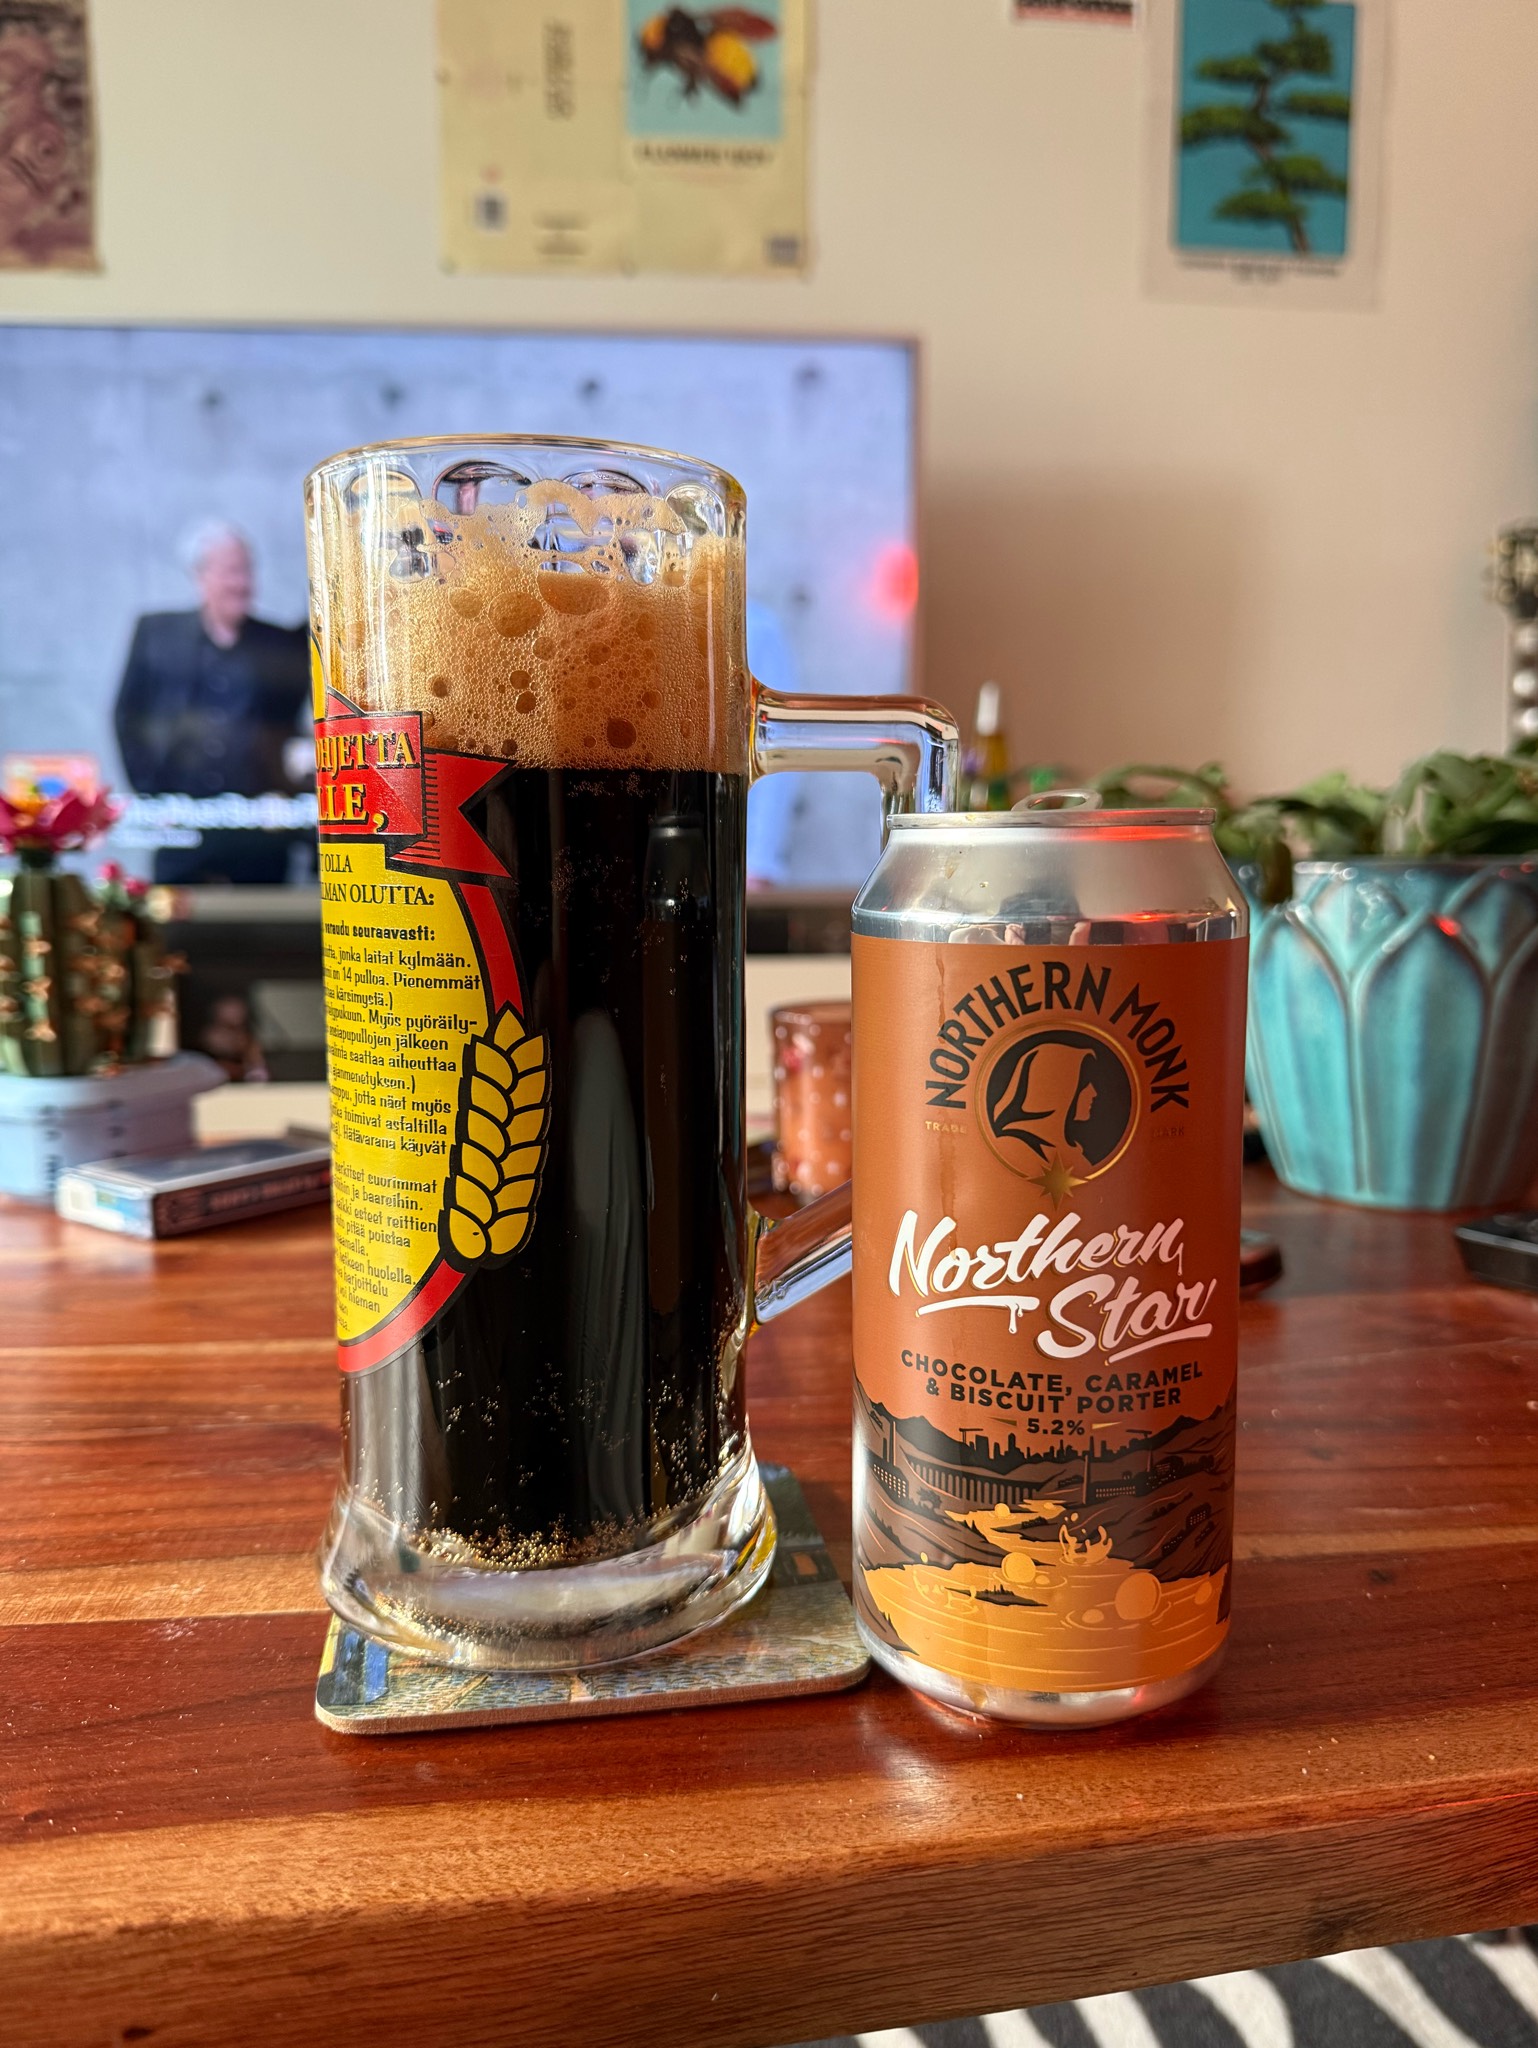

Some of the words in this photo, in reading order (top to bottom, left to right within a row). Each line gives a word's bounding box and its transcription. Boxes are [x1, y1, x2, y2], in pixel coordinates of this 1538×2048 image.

[324, 853, 352, 873] OLLA
[349, 885, 435, 906] OLUTTA:
[352, 924, 436, 942] seuraavasti:
[337, 947, 361, 965] jonka
[363, 948, 395, 965] laitat
[398, 950, 472, 970] kylmään.
[342, 967, 352, 982] 14
[354, 968, 390, 987] pulloa.
[393, 971, 481, 991] Pienemmät
[368, 1008, 402, 1030] Myös
[405, 1012, 479, 1035] pyöräily-
[394, 1031, 449, 1052] jälkeen
[925, 961, 1112, 1110] NORTHERN
[1109, 982, 1190, 1113] MONK
[349, 1050, 385, 1068] saattaa
[387, 1052, 457, 1073] aiheuttaa
[353, 1088, 377, 1107] jotta
[379, 1092, 407, 1109] näet
[411, 1097, 452, 1117] myös
[385, 1115, 447, 1135] asfaltilla
[400, 1135, 447, 1157] käyvät
[367, 1173, 438, 1195] suorimmat
[362, 1187, 424, 1212] baareihin.
[346, 1219, 366, 1240] pitää
[367, 1227, 412, 1248] poistaa
[386, 1214, 438, 1234] reittien
[888, 1209, 1185, 1298] Northern
[366, 1264, 417, 1286] huolella.
[347, 1287, 381, 1314] hieman
[1036, 1273, 1218, 1359] Star
[901, 1349, 1073, 1396] CHOCOLATE,
[1085, 1360, 1204, 1394] CARAMEL
[926, 1377, 940, 1397] &
[950, 1382, 1067, 1414] BISCUIT
[1077, 1386, 1182, 1414] PORTER
[1027, 1418, 1086, 1436] 5.2%
